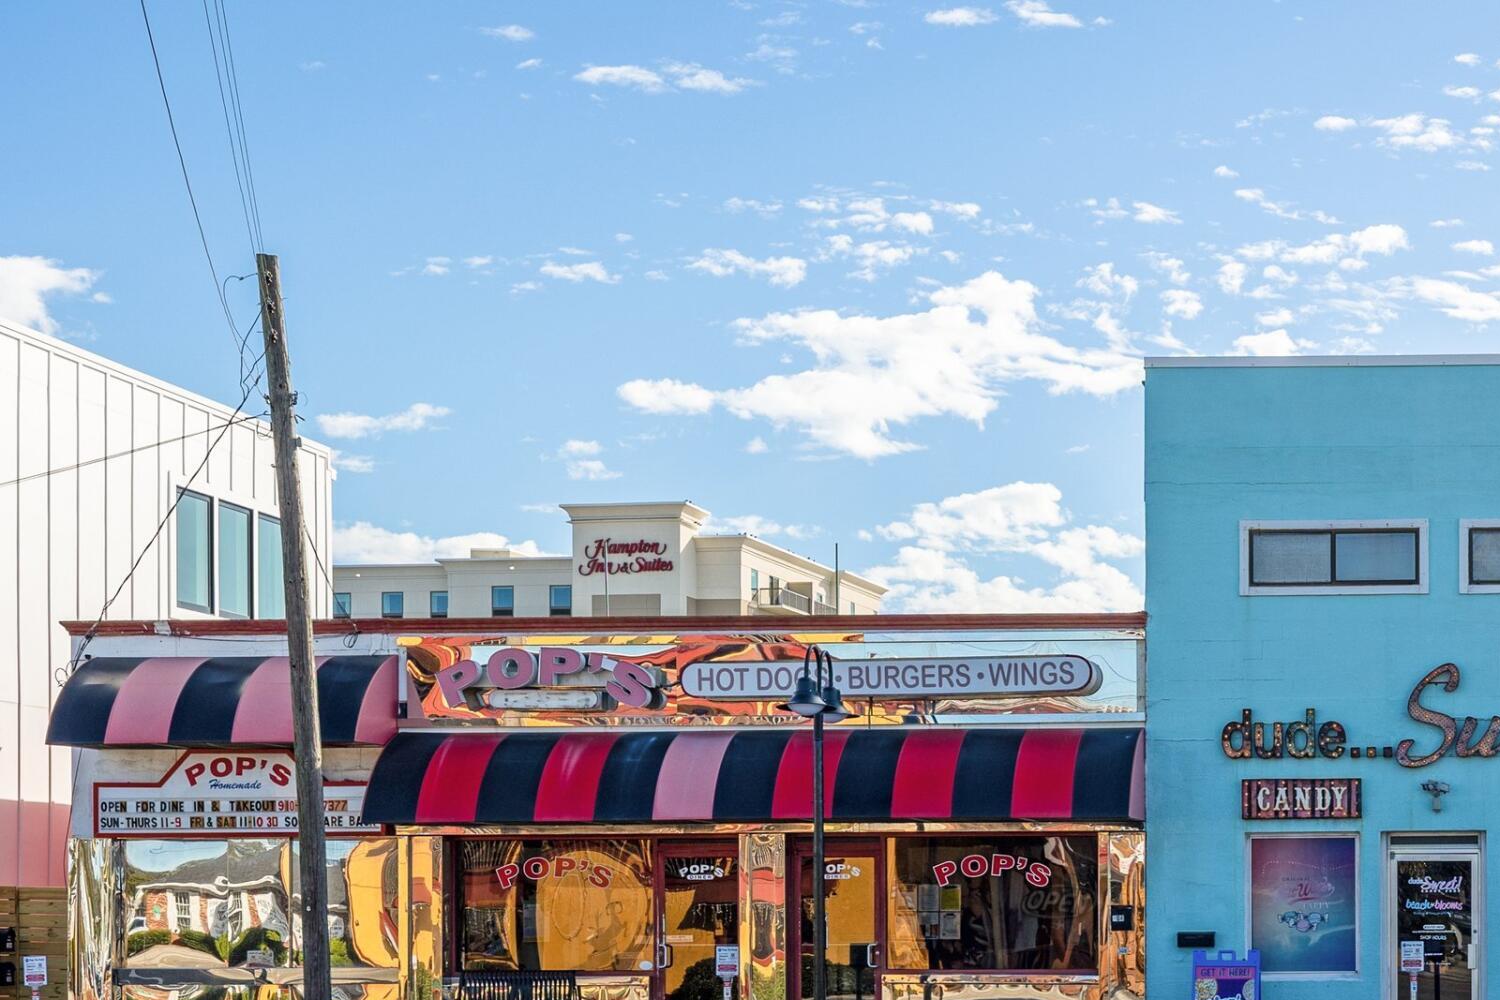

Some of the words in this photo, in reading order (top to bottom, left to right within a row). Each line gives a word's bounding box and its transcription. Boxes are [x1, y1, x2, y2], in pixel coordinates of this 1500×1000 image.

[585, 538, 667, 559] Hampton
[579, 559, 620, 576] Inn
[620, 562, 630, 574] &
[630, 557, 673, 573] Suites
[436, 647, 657, 709] POP'S
[697, 667, 749, 691] HOT
[849, 663, 970, 690] BURGERS
[987, 661, 1075, 687] WINGS
[184, 756, 292, 787] POP'S
[209, 779, 262, 790] Homemade
[100, 801, 127, 813] OPEN
[136, 801, 156, 813] FOR
[160, 801, 184, 813] DINE
[194, 801, 204, 813] IN
[229, 801, 275, 813] TAKEOUT
[1257, 786, 1347, 811] CANDY
[190, 817, 205, 828] FRI
[207, 817, 214, 828] &
[217, 817, 236, 828] SAT
[495, 855, 613, 890] POP'S
[680, 864, 724, 878] POP'S
[825, 864, 861, 877] OP'S
[932, 853, 1052, 888] POP'S
[1201, 969, 1215, 977] GET
